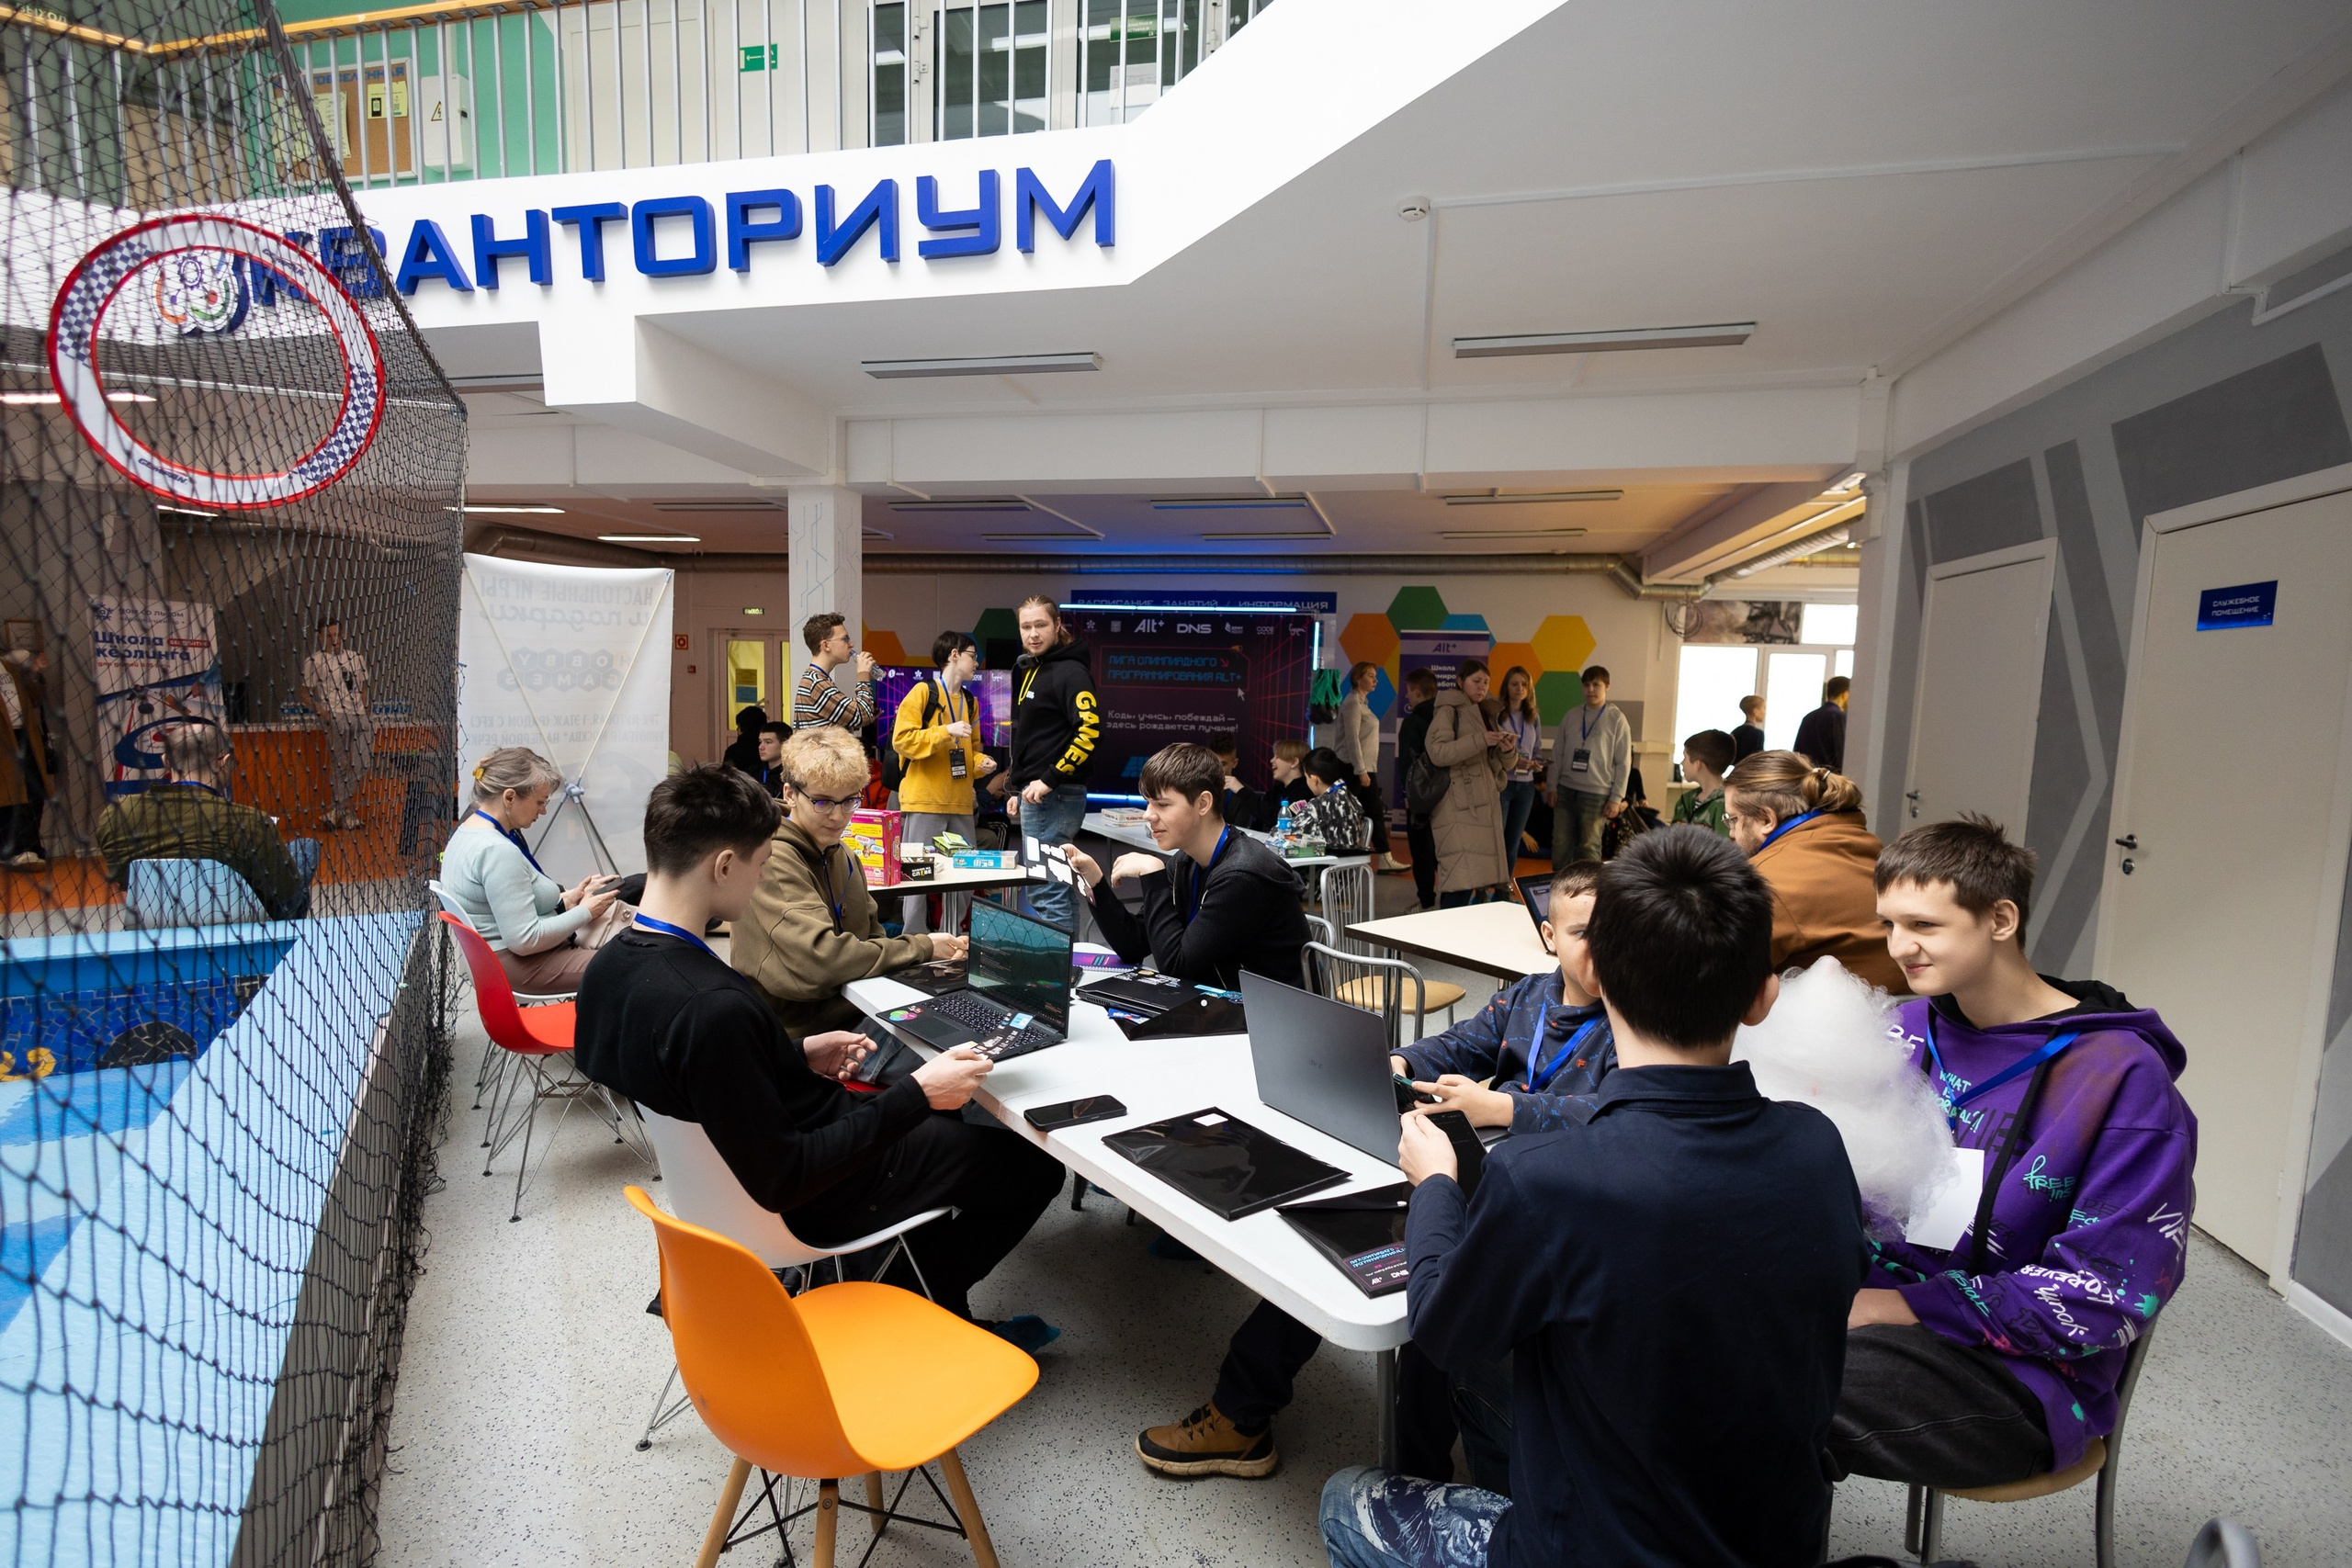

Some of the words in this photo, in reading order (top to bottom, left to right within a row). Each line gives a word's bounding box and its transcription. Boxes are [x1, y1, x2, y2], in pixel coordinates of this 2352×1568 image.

[251, 158, 1116, 309] КВАНТОРИУМ
[1238, 600, 1329, 610] ИНФОРМАЦИЯ
[2212, 595, 2260, 607] СЛУЖЕБНОЕ
[2211, 606, 2259, 616] ПОМЕЩЕНИЕ
[1177, 624, 1212, 634] DNS
[94, 631, 164, 647] Школа
[1109, 655, 1136, 665] ЛИГА
[1137, 656, 1217, 667] ОЛИМПИАДНОГО
[1107, 670, 1213, 682] ПРОГРАММИРОВАНИЯ
[1174, 714, 1226, 723] побеждай
[1056, 691, 1100, 775] GAMES
[1139, 722, 1195, 731] рождаются
[1198, 723, 1238, 733] лучшие!
[1390, 1269, 1409, 1279] DNS
